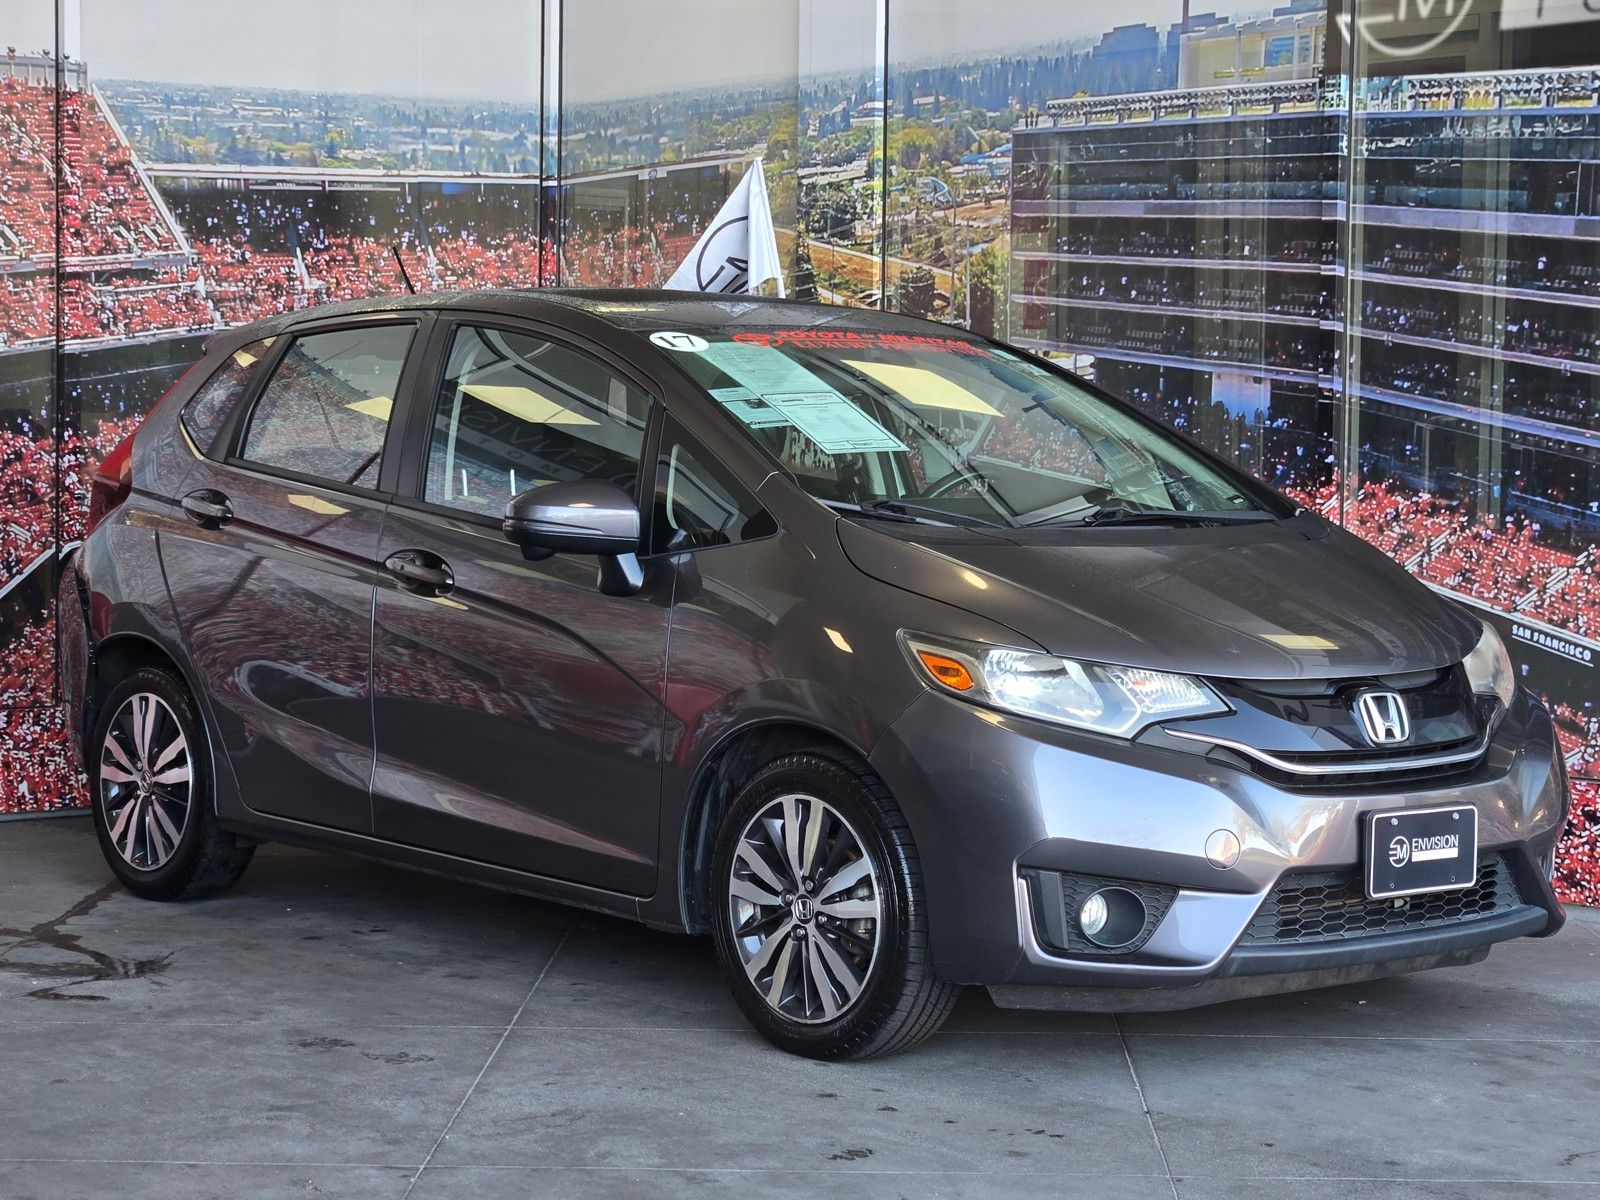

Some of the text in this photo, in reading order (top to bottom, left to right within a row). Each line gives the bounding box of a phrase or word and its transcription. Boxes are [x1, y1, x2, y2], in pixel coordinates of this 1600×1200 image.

[654, 335, 697, 348] 17
[1511, 624, 1592, 661] SAN FRANCISCO
[1412, 834, 1459, 852] ENVISION
